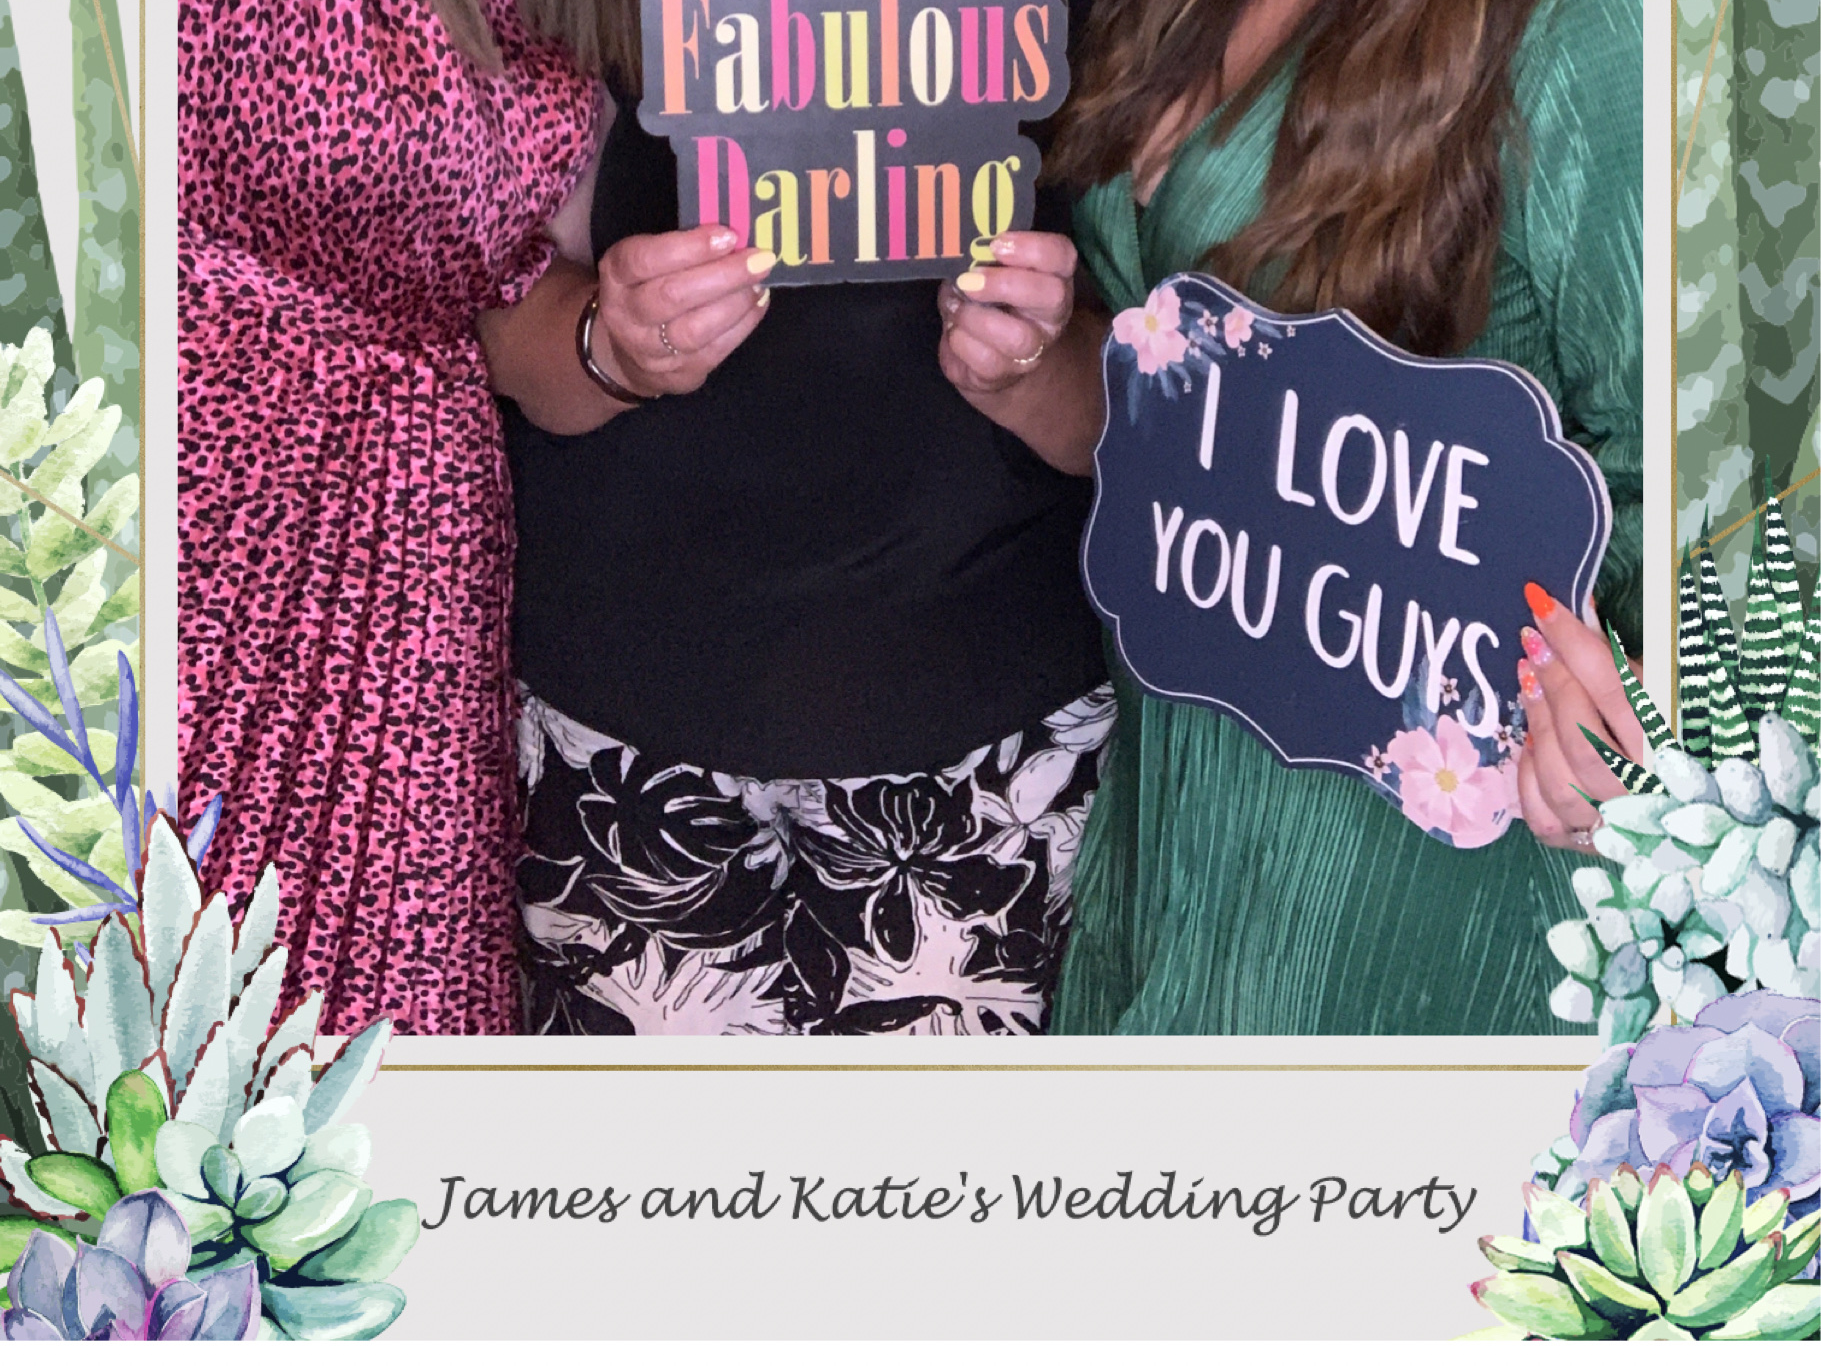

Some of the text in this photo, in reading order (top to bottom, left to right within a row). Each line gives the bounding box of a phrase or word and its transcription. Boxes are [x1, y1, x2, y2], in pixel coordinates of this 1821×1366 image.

[692, 128, 1021, 273] Darling
[1199, 362, 1490, 566] I LOVE
[1153, 501, 1500, 739] YOU GUYS
